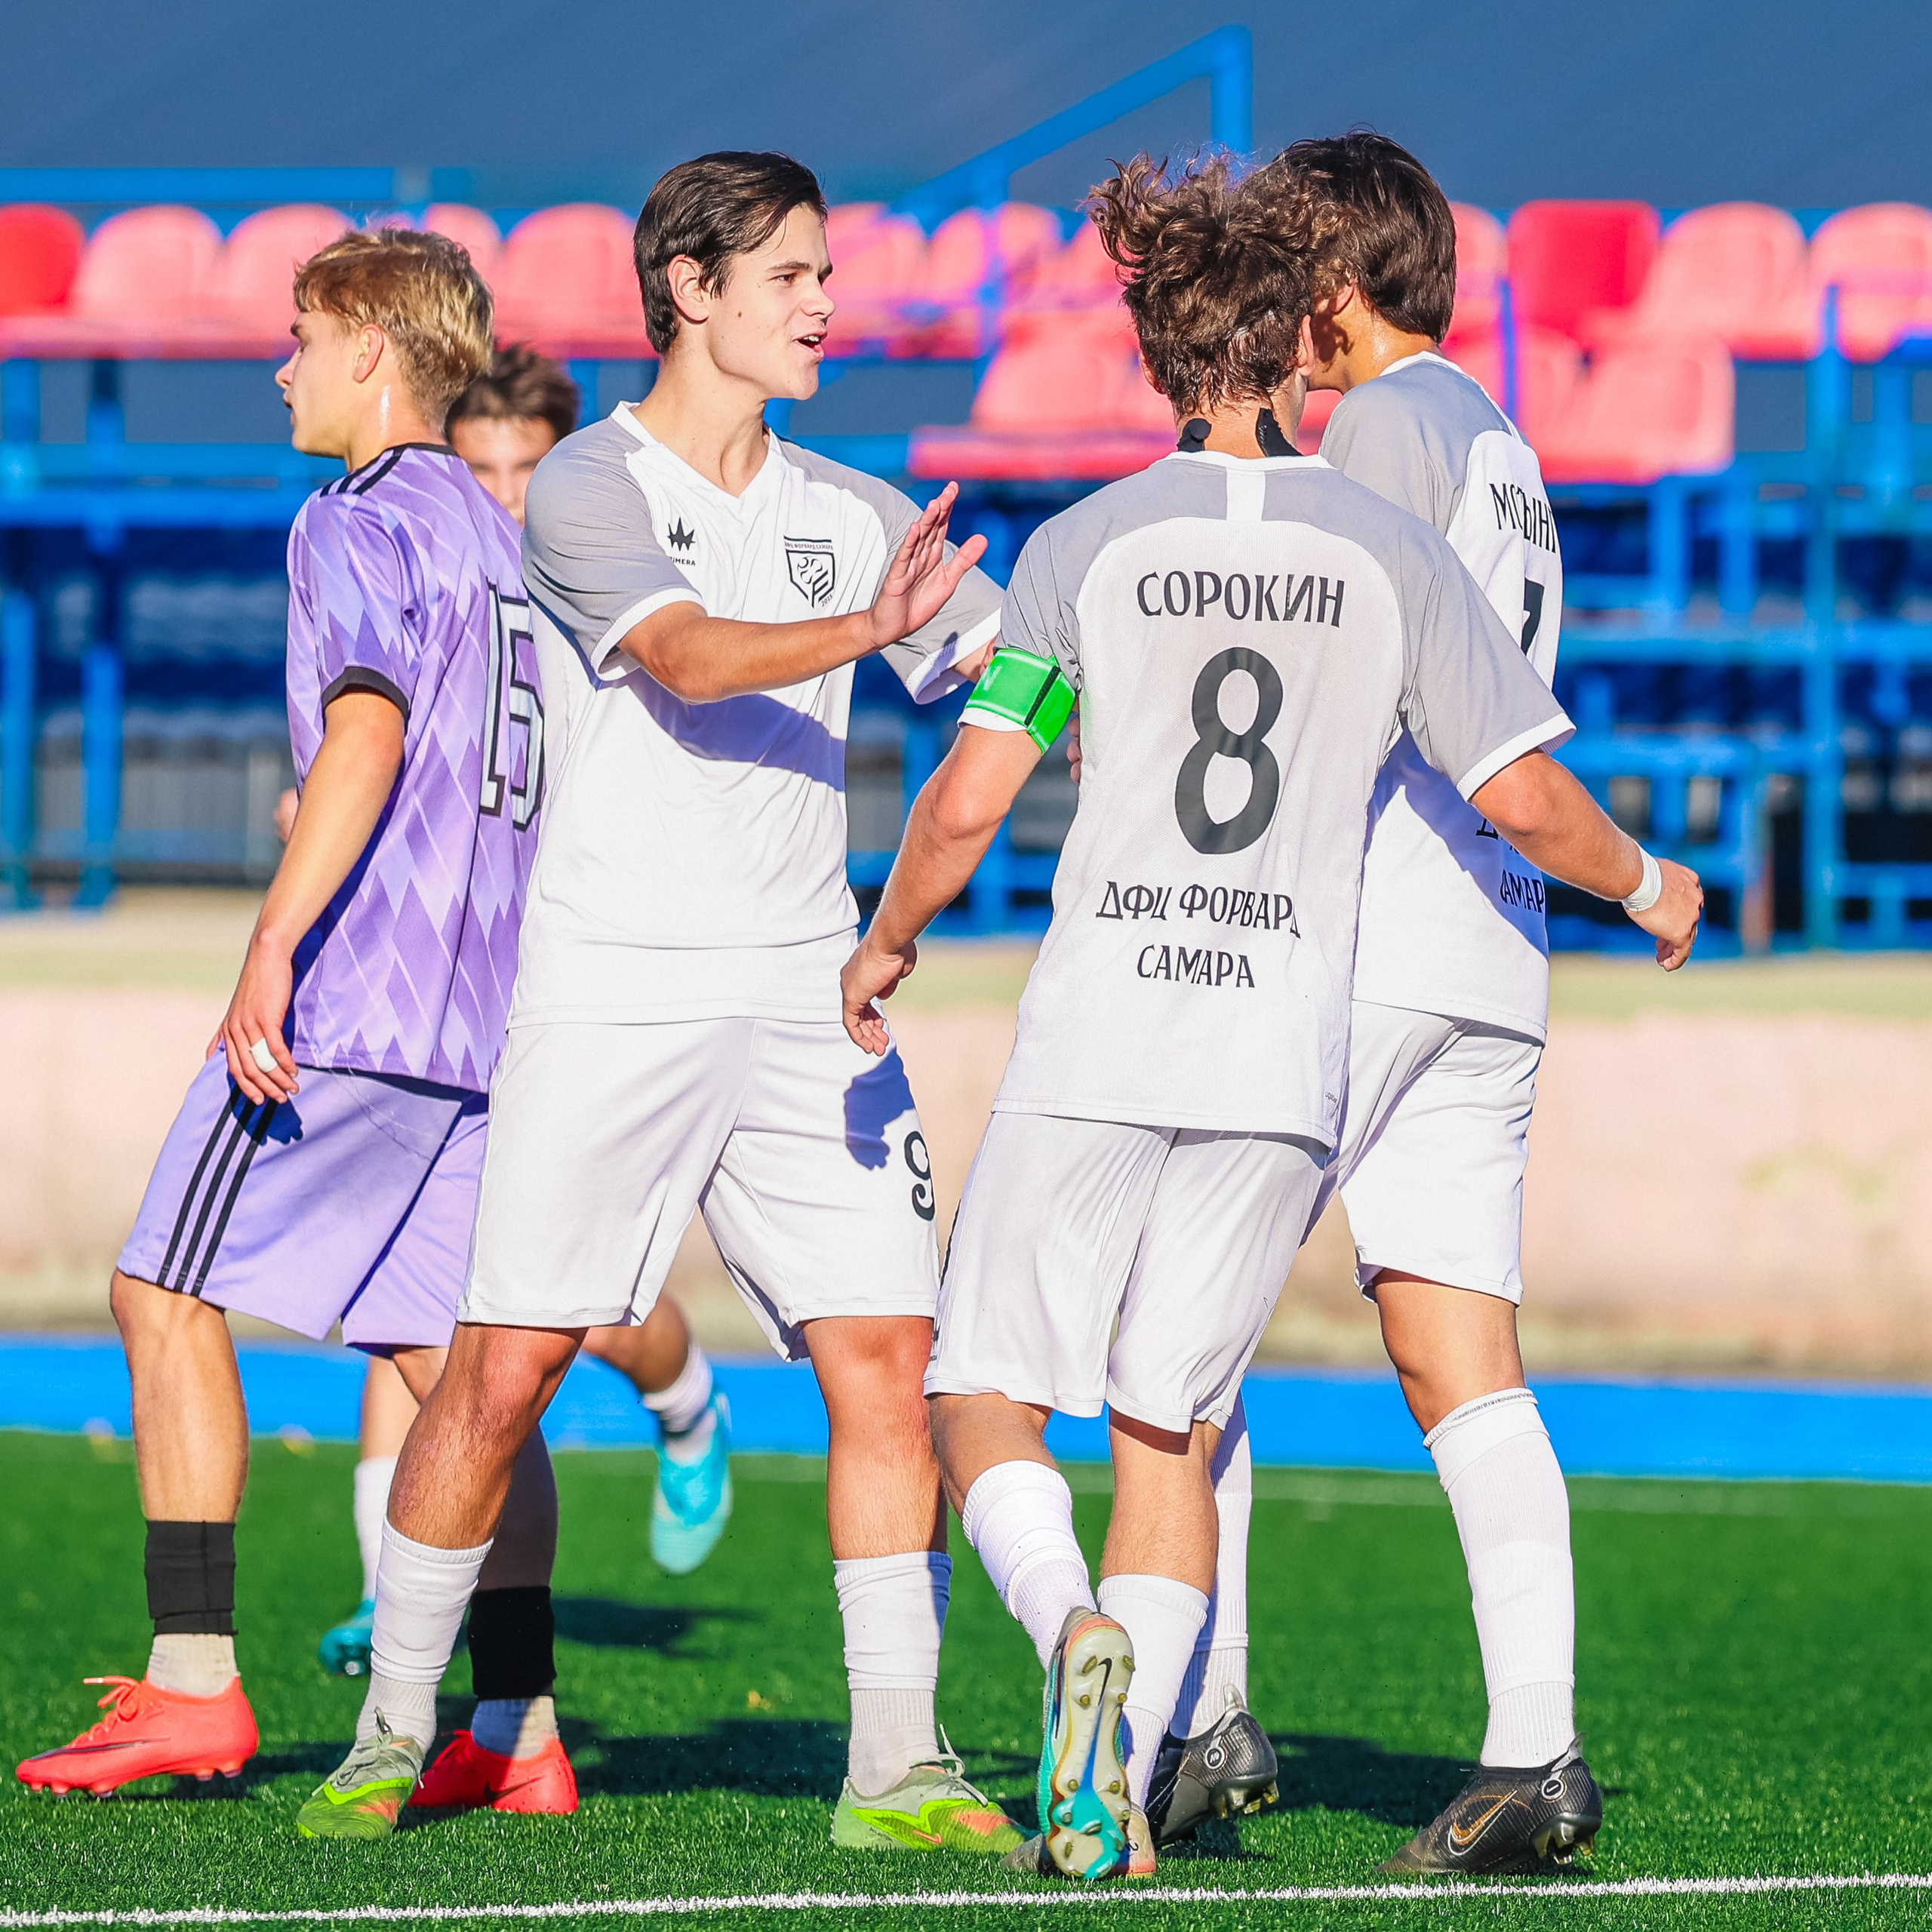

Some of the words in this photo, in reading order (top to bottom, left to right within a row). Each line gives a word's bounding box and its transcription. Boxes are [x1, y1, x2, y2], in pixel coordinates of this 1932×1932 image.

[1137, 571, 1346, 628] СОРОКИН
[479, 576, 545, 832] 15
[1174, 647, 1284, 855] 8
[1095, 881, 1173, 921] ДФЦ
[1179, 884, 1301, 940] ФОРВАРД
[1137, 944, 1256, 989] САМАРА
[904, 1131, 935, 1221] 9
